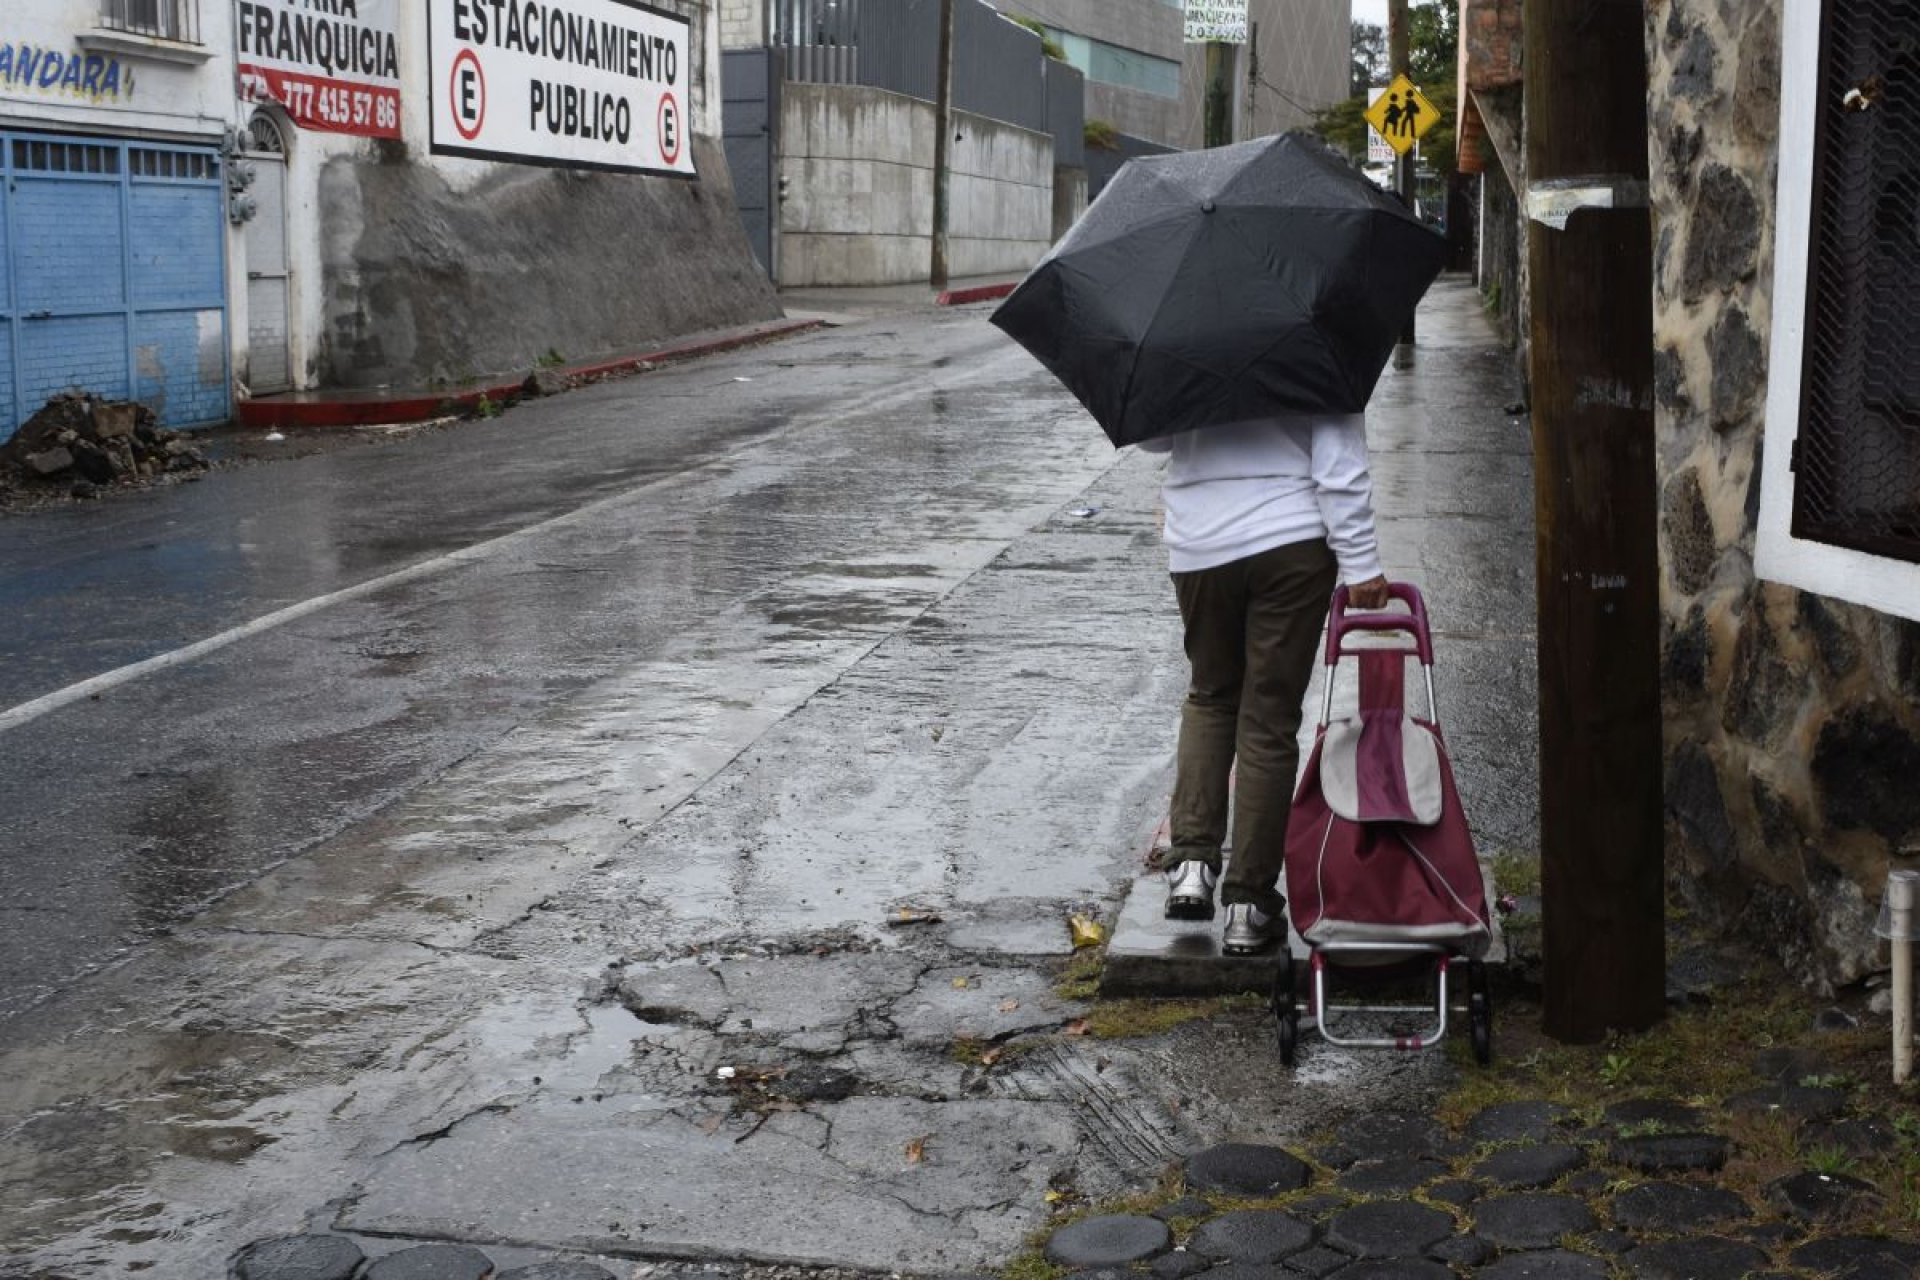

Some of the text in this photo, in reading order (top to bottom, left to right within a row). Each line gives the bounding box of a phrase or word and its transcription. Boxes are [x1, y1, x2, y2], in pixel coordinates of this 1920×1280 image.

[239, 1, 399, 79] FRANQUICIA
[453, 0, 677, 86] ESTACIONAMIENTO
[282, 80, 314, 119] 777
[318, 86, 350, 124] 415
[353, 91, 371, 126] 57
[375, 95, 396, 129] 86
[461, 69, 476, 121] E
[530, 79, 631, 145] PUBLICO
[664, 108, 674, 148] E
